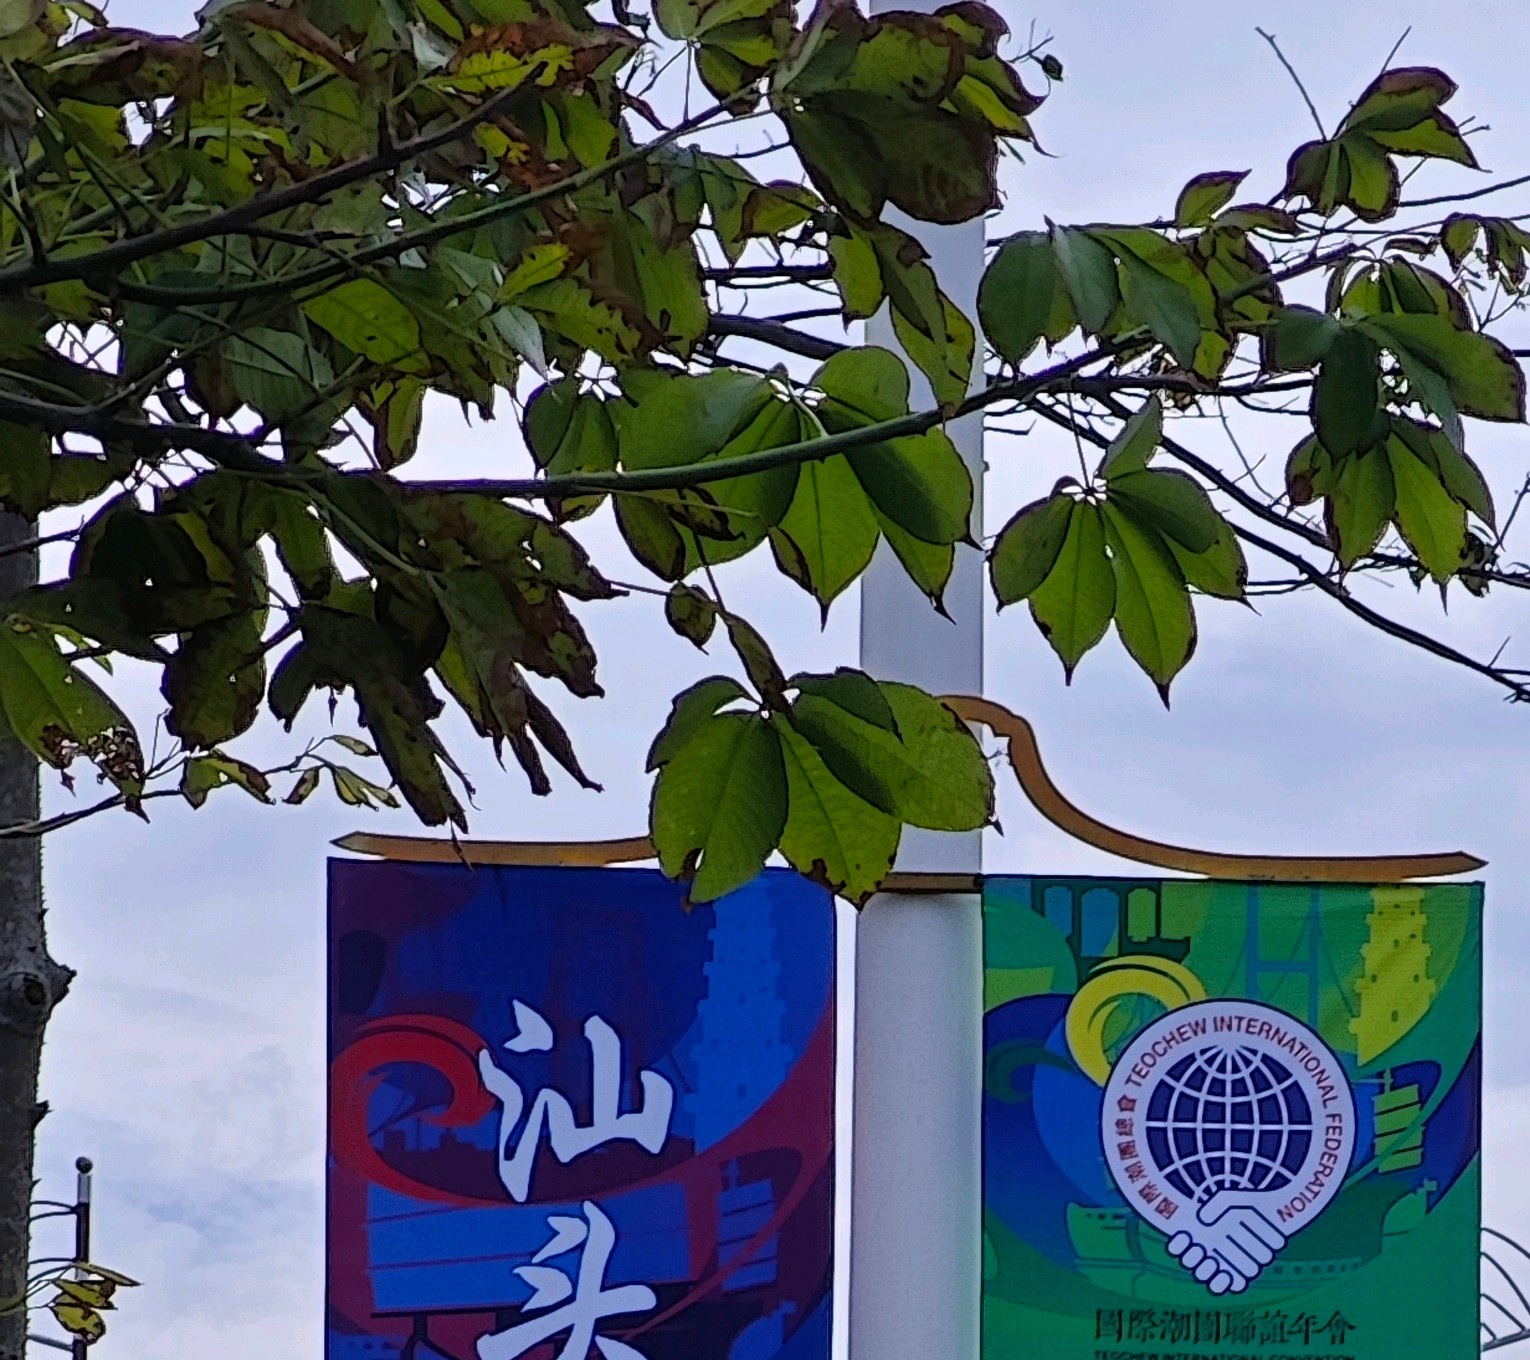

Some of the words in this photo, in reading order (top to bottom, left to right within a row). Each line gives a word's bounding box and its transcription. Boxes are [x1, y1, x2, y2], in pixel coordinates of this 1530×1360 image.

[1125, 1017, 1207, 1088] TEOCHEW
[1213, 1015, 1339, 1109] INTERNATIONAL
[1276, 1113, 1343, 1223] FEDERATION
